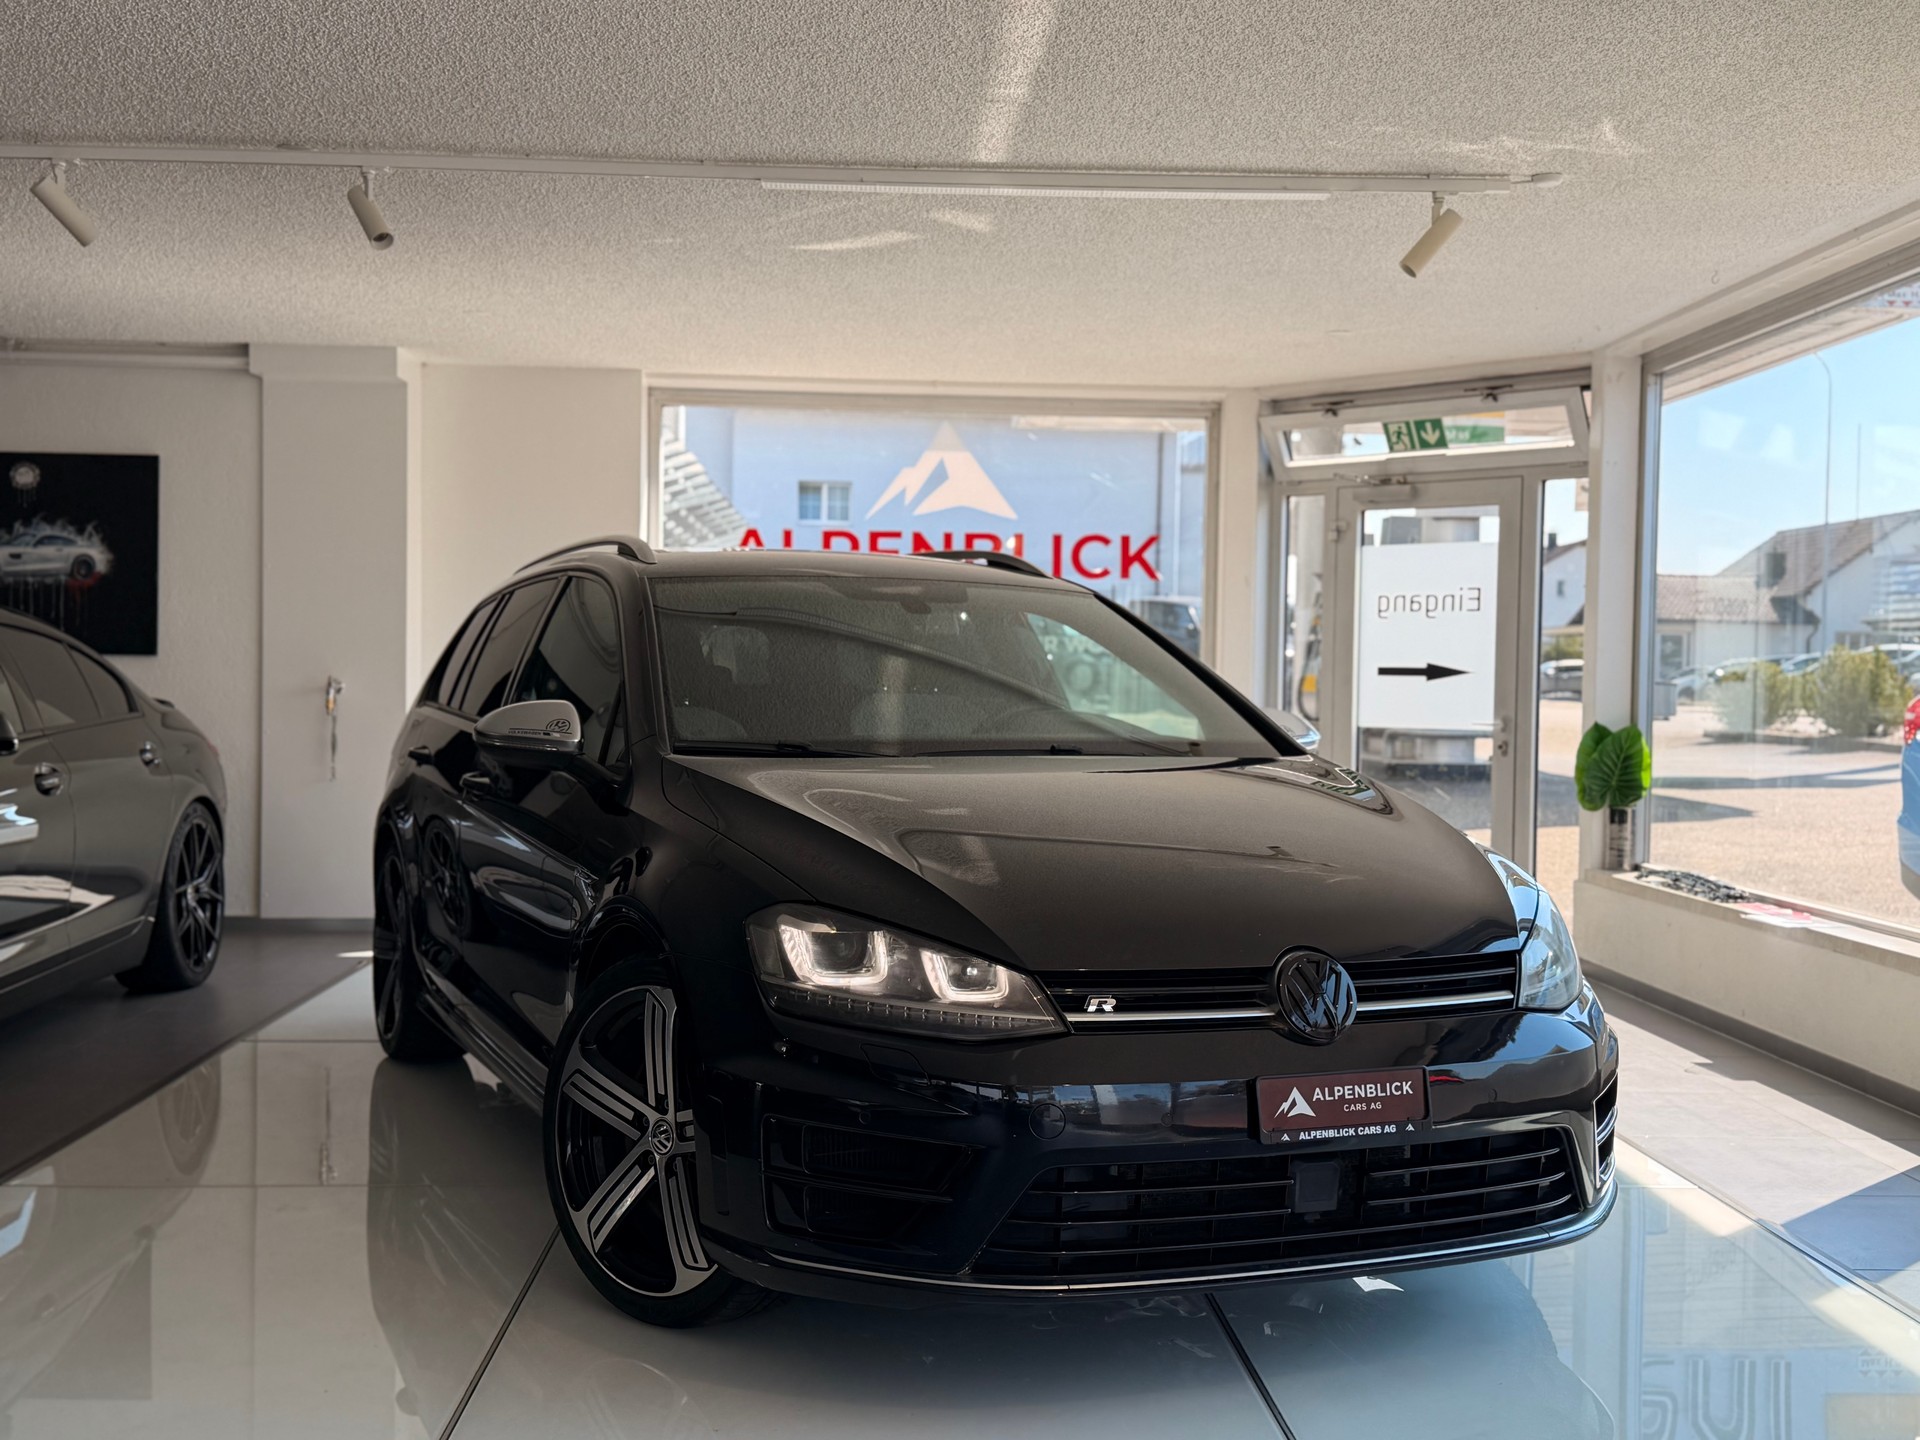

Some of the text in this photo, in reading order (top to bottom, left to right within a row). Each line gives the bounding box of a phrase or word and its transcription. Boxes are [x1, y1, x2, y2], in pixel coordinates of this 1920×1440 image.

[1084, 994, 1117, 1013] R
[1313, 1081, 1413, 1101] ALPENBLICK
[1343, 1102, 1382, 1112] CARS AG
[1298, 1124, 1396, 1140] ALPENBLICK CARS AG
